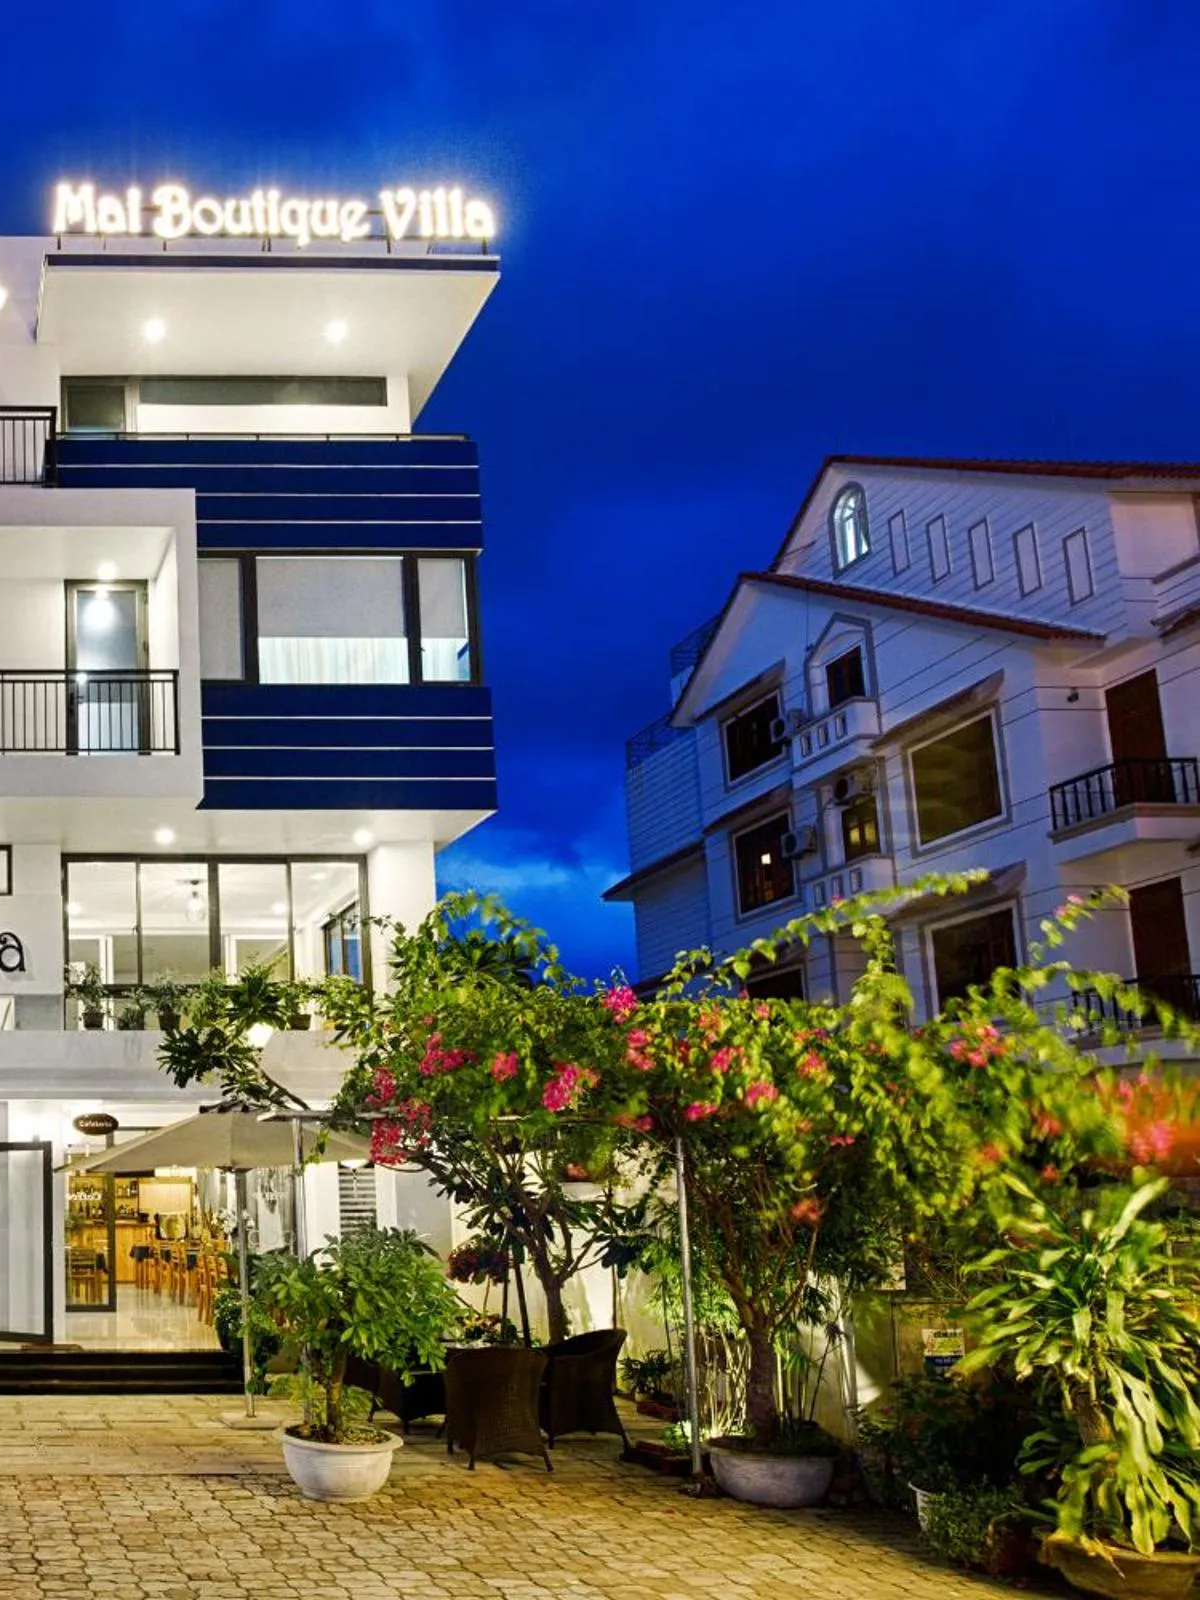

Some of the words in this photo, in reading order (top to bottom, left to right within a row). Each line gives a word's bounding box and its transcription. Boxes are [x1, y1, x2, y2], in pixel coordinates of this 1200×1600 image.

[53, 183, 141, 235] Mai
[152, 184, 371, 246] Boutique
[380, 186, 496, 239] Villa
